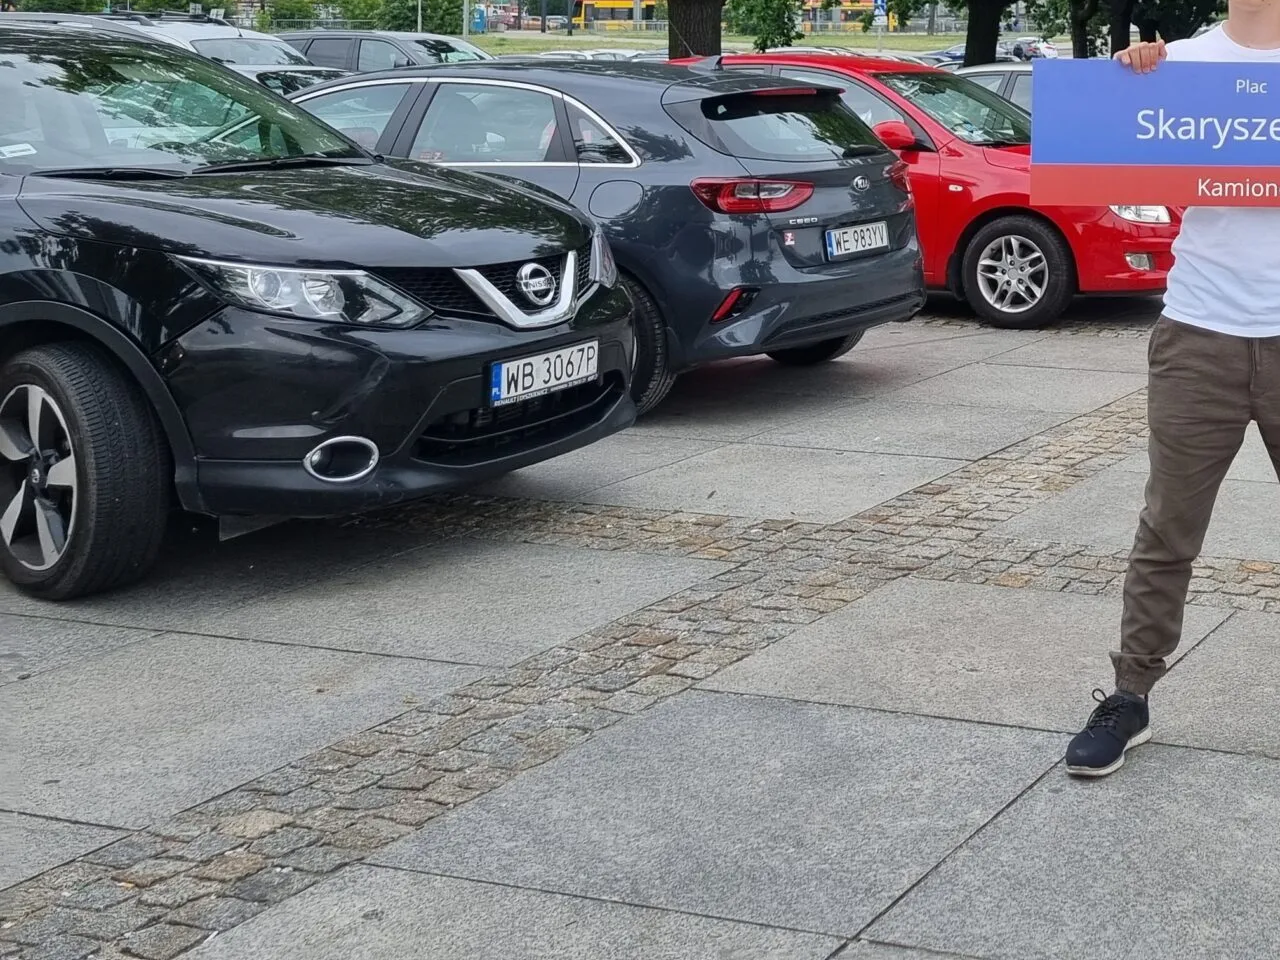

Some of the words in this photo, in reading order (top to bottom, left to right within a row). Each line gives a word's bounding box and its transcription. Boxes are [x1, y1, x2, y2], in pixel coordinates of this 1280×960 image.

[1236, 79, 1268, 93] Plac
[834, 231, 851, 252] WE
[853, 223, 885, 250] 983YV
[506, 362, 535, 395] WB
[542, 345, 596, 385] 3067P
